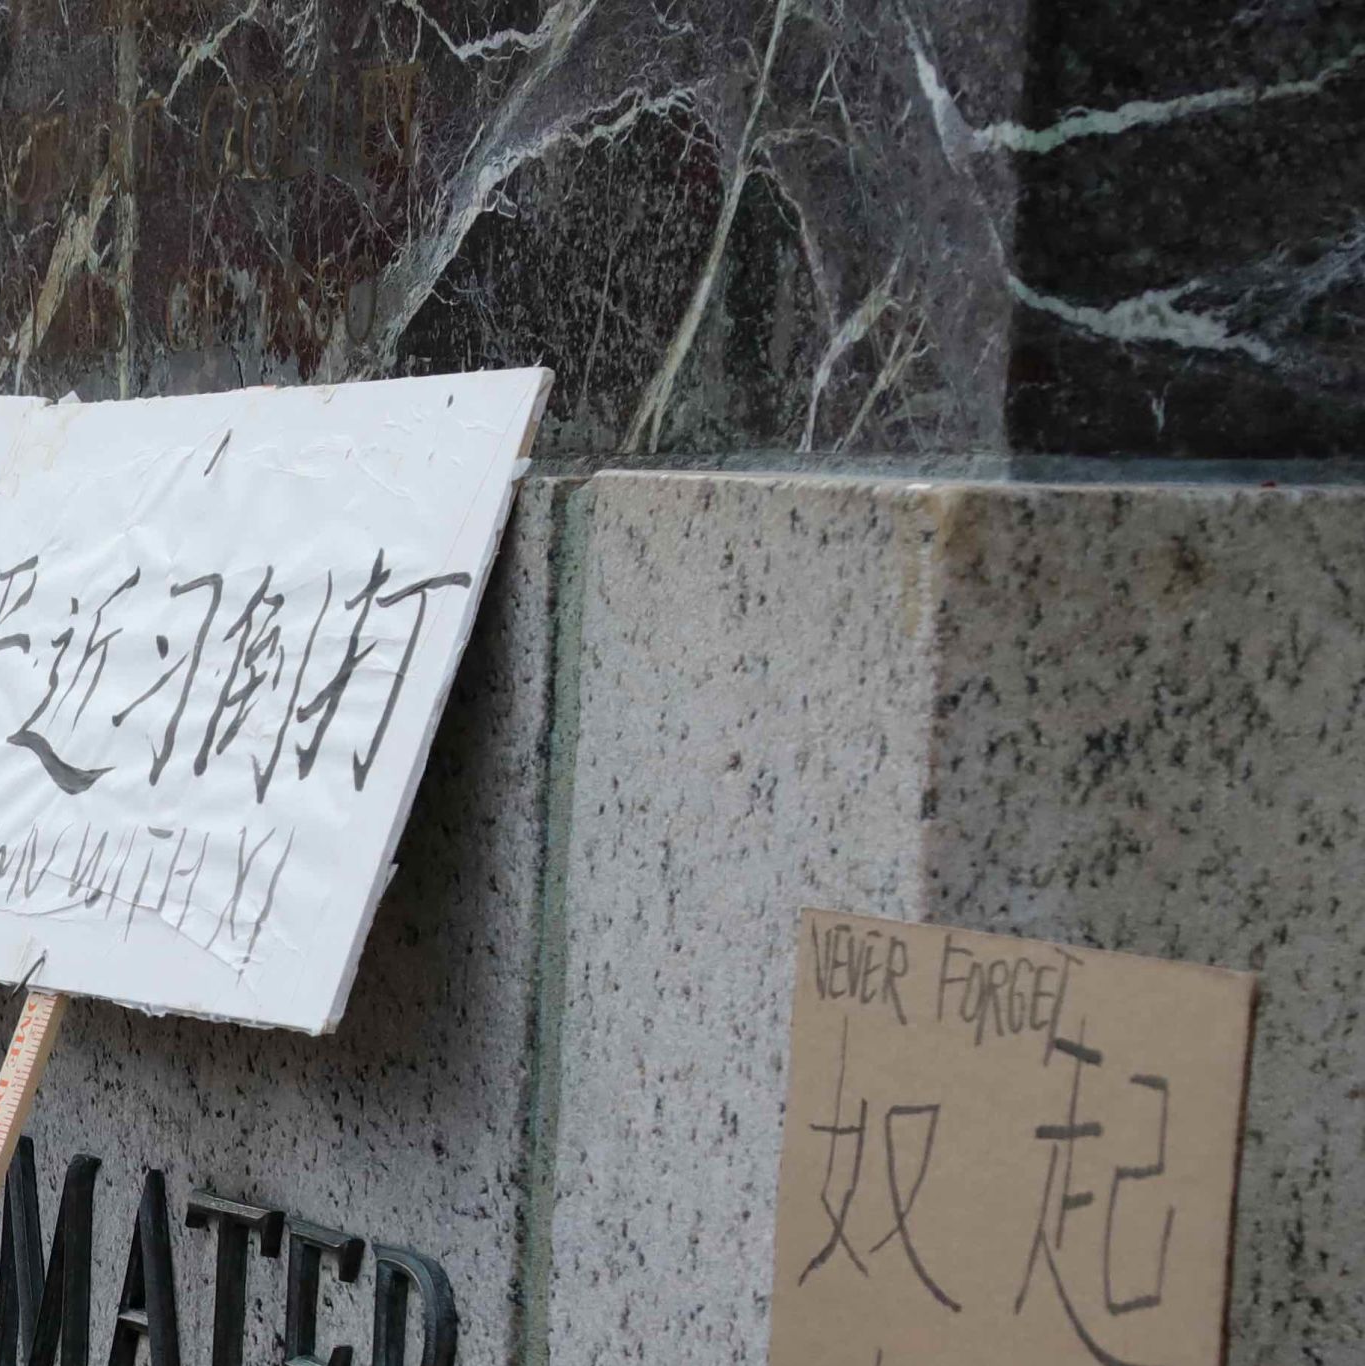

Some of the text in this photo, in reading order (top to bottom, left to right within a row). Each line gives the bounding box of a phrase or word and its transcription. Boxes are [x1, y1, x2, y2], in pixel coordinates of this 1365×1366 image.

[71, 827, 209, 942] WITH
[206, 826, 295, 965] XI
[4, 995, 39, 1069] OME
[938, 931, 1086, 1066] FORGET
